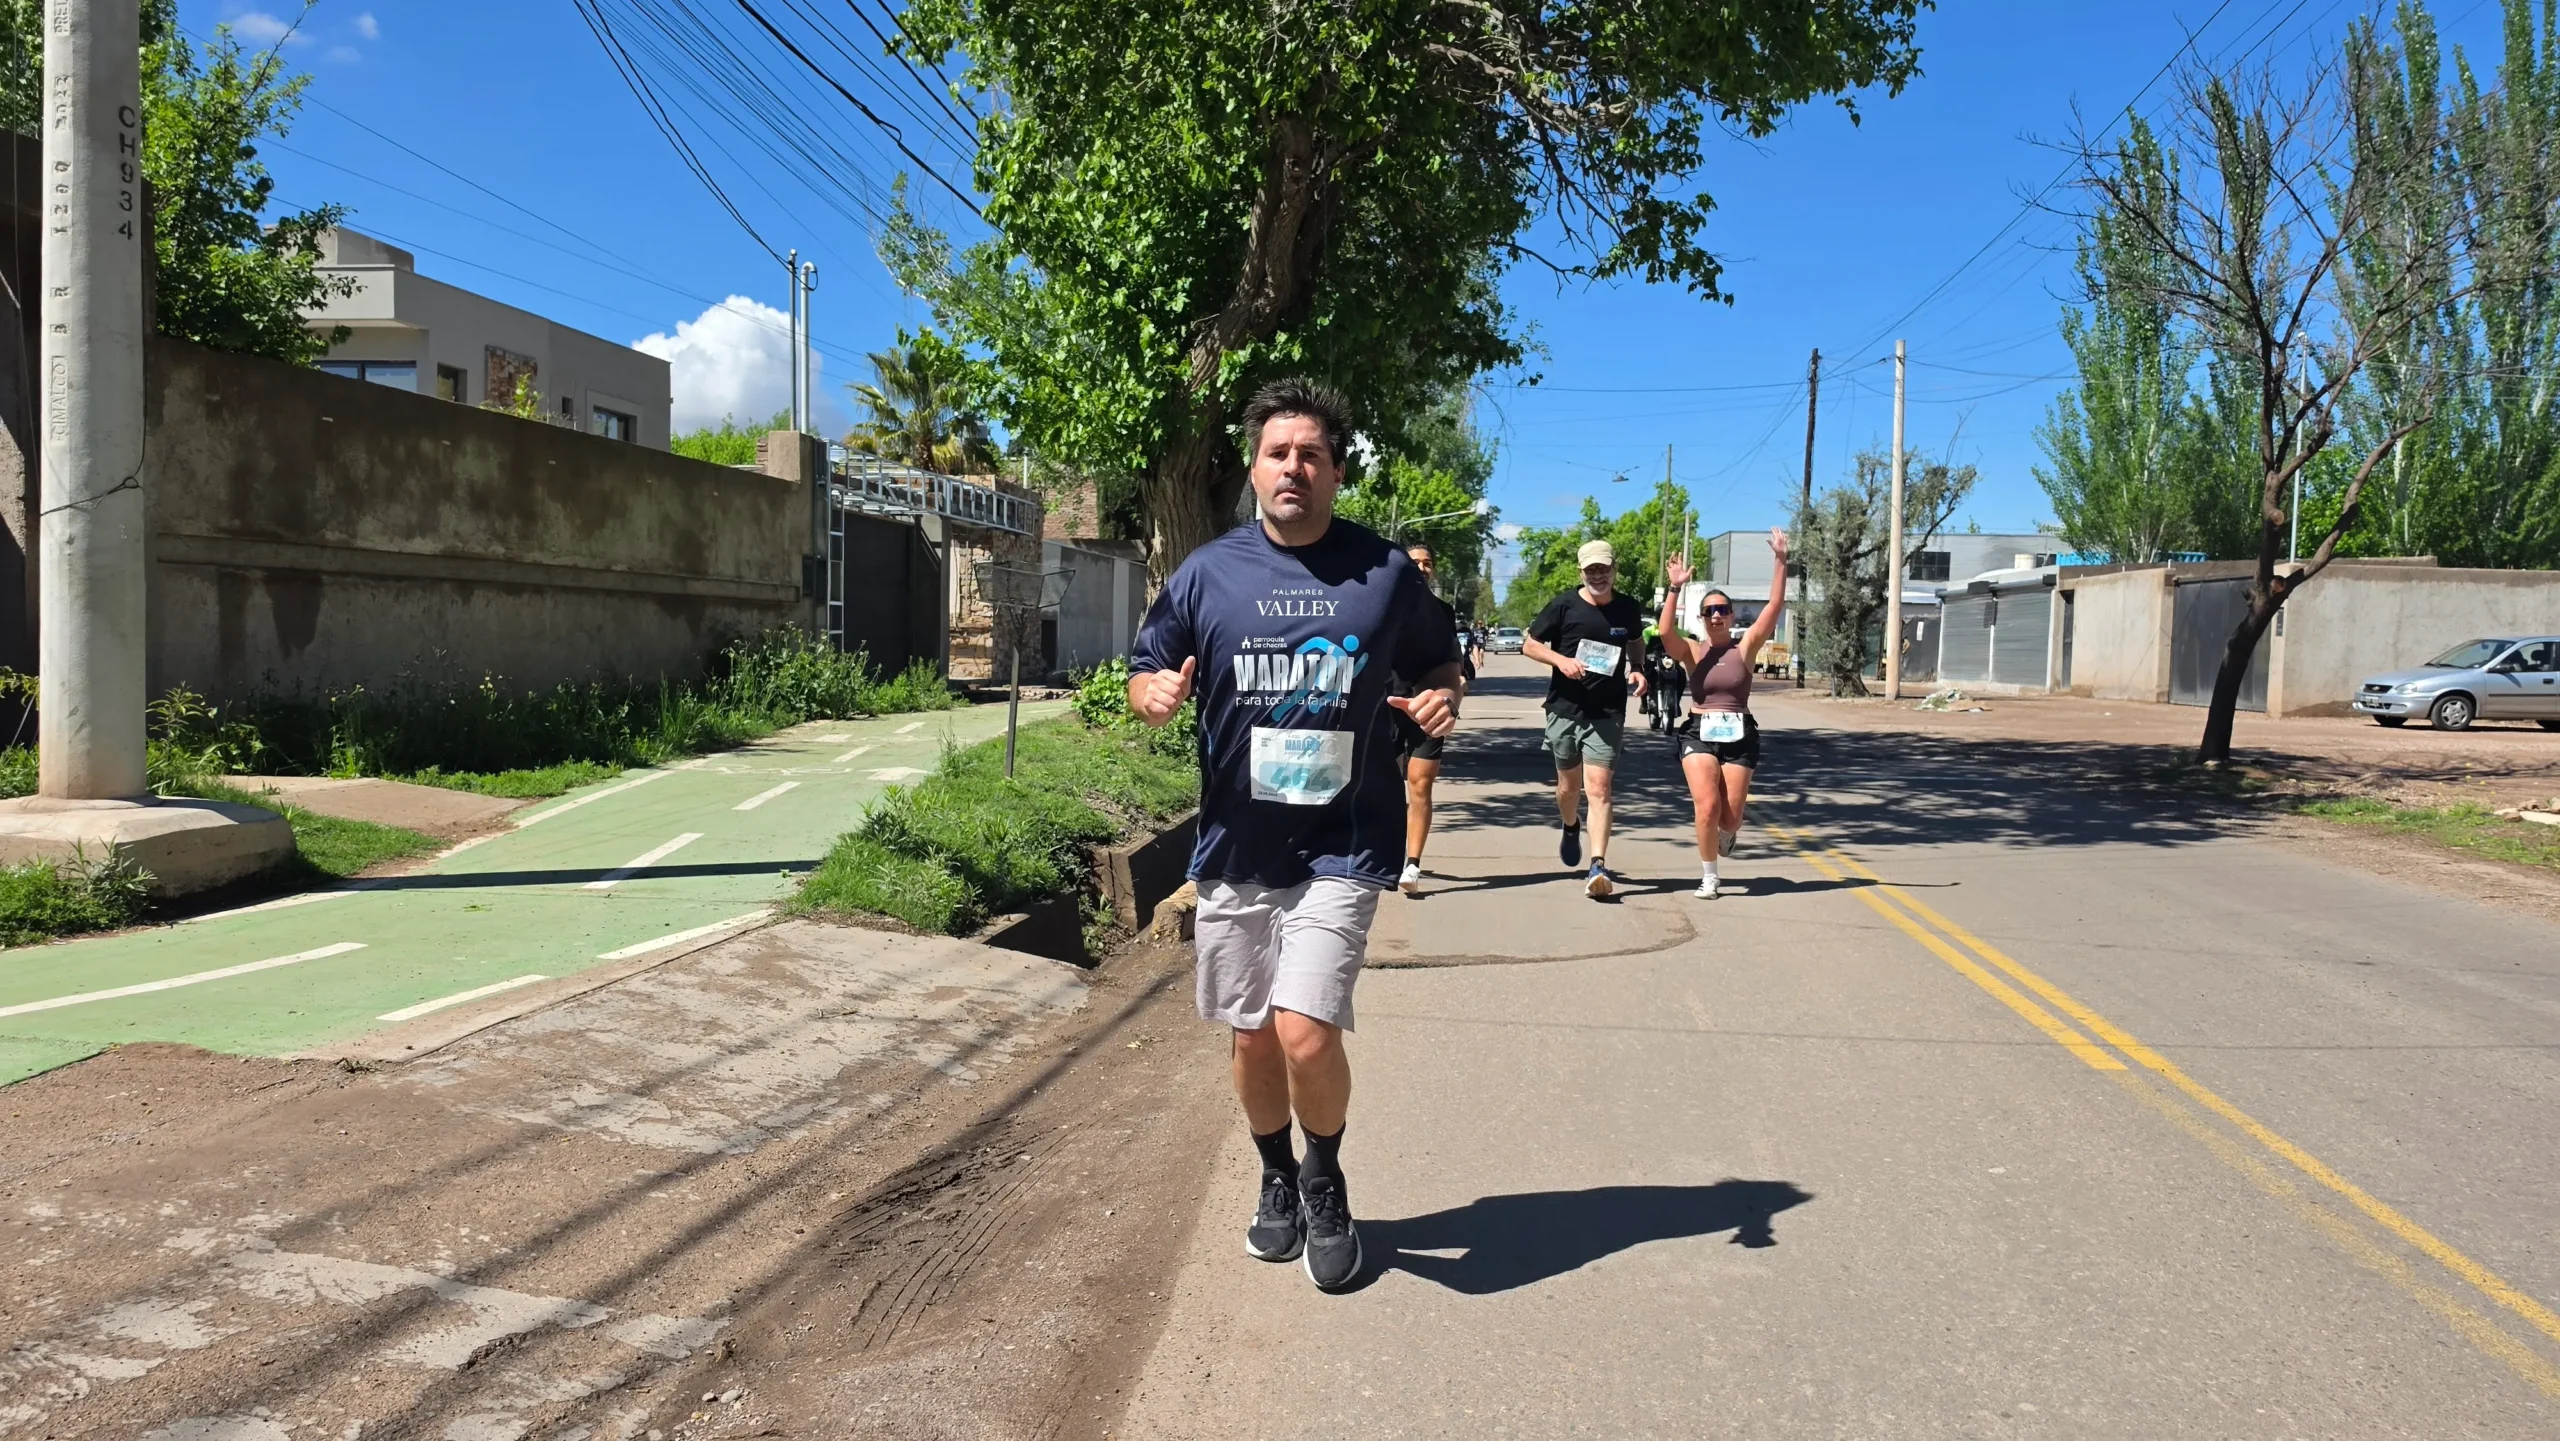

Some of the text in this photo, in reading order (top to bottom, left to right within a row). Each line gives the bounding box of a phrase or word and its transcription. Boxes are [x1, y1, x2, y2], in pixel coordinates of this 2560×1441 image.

[1272, 588, 1324, 596] PALMARES
[1256, 600, 1340, 617] VALLEY
[1253, 636, 1285, 645] parroquia
[1262, 641, 1288, 649] chacras
[1233, 646, 1354, 693] MARATÓN
[1235, 693, 1348, 709] para toda la familia
